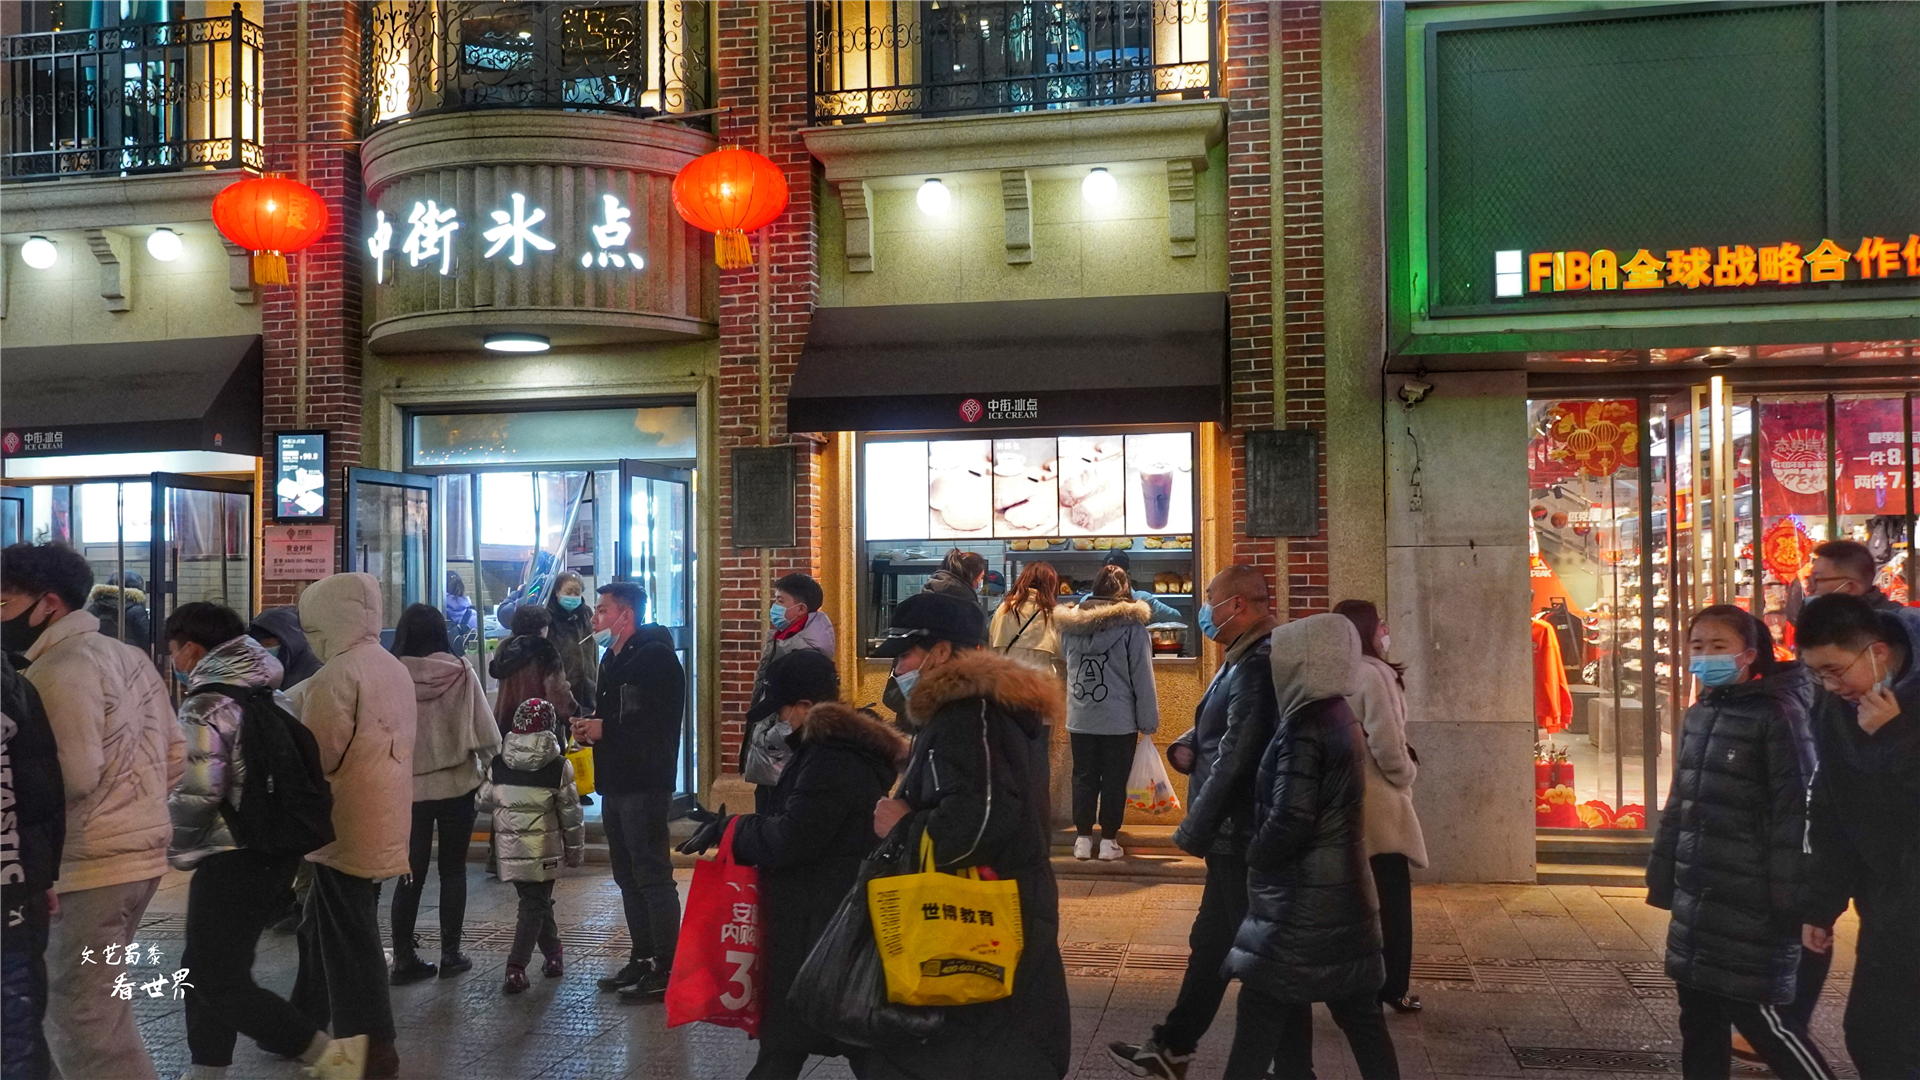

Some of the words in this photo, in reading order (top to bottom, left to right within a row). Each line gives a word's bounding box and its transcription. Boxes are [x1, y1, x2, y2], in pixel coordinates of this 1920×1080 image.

[1005, 411, 1038, 419] CREAM
[37, 442, 63, 450] CREAM
[1530, 569, 1552, 577] PEAK
